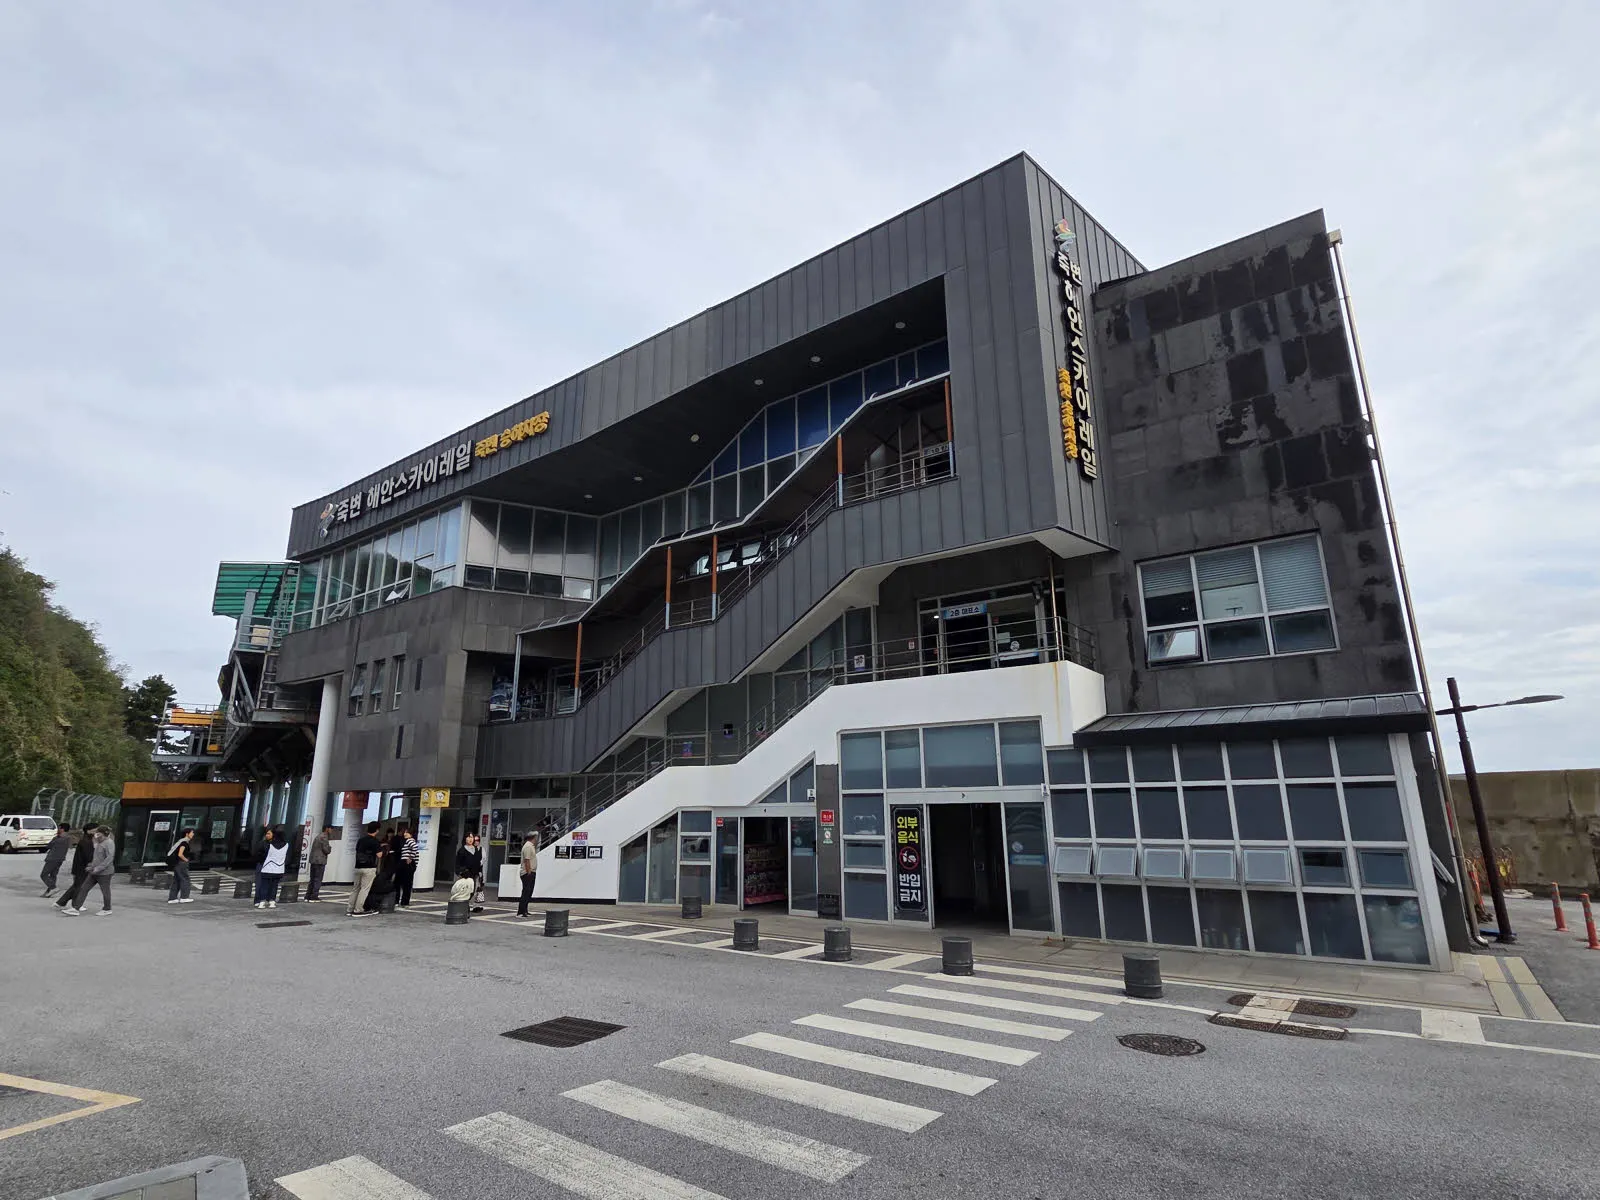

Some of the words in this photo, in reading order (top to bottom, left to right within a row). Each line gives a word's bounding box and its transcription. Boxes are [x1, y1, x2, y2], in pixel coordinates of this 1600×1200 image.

[1058, 250, 1083, 287] 죽변
[1064, 278, 1098, 480] 해안스카이레일
[336, 491, 361, 522] 죽변
[367, 440, 471, 508] 해안스카이레일
[474, 433, 499, 458] 죽변
[897, 816, 918, 829] 외부
[897, 831, 919, 844] 음식
[899, 873, 921, 887] 반입
[900, 888, 922, 903] 금지
